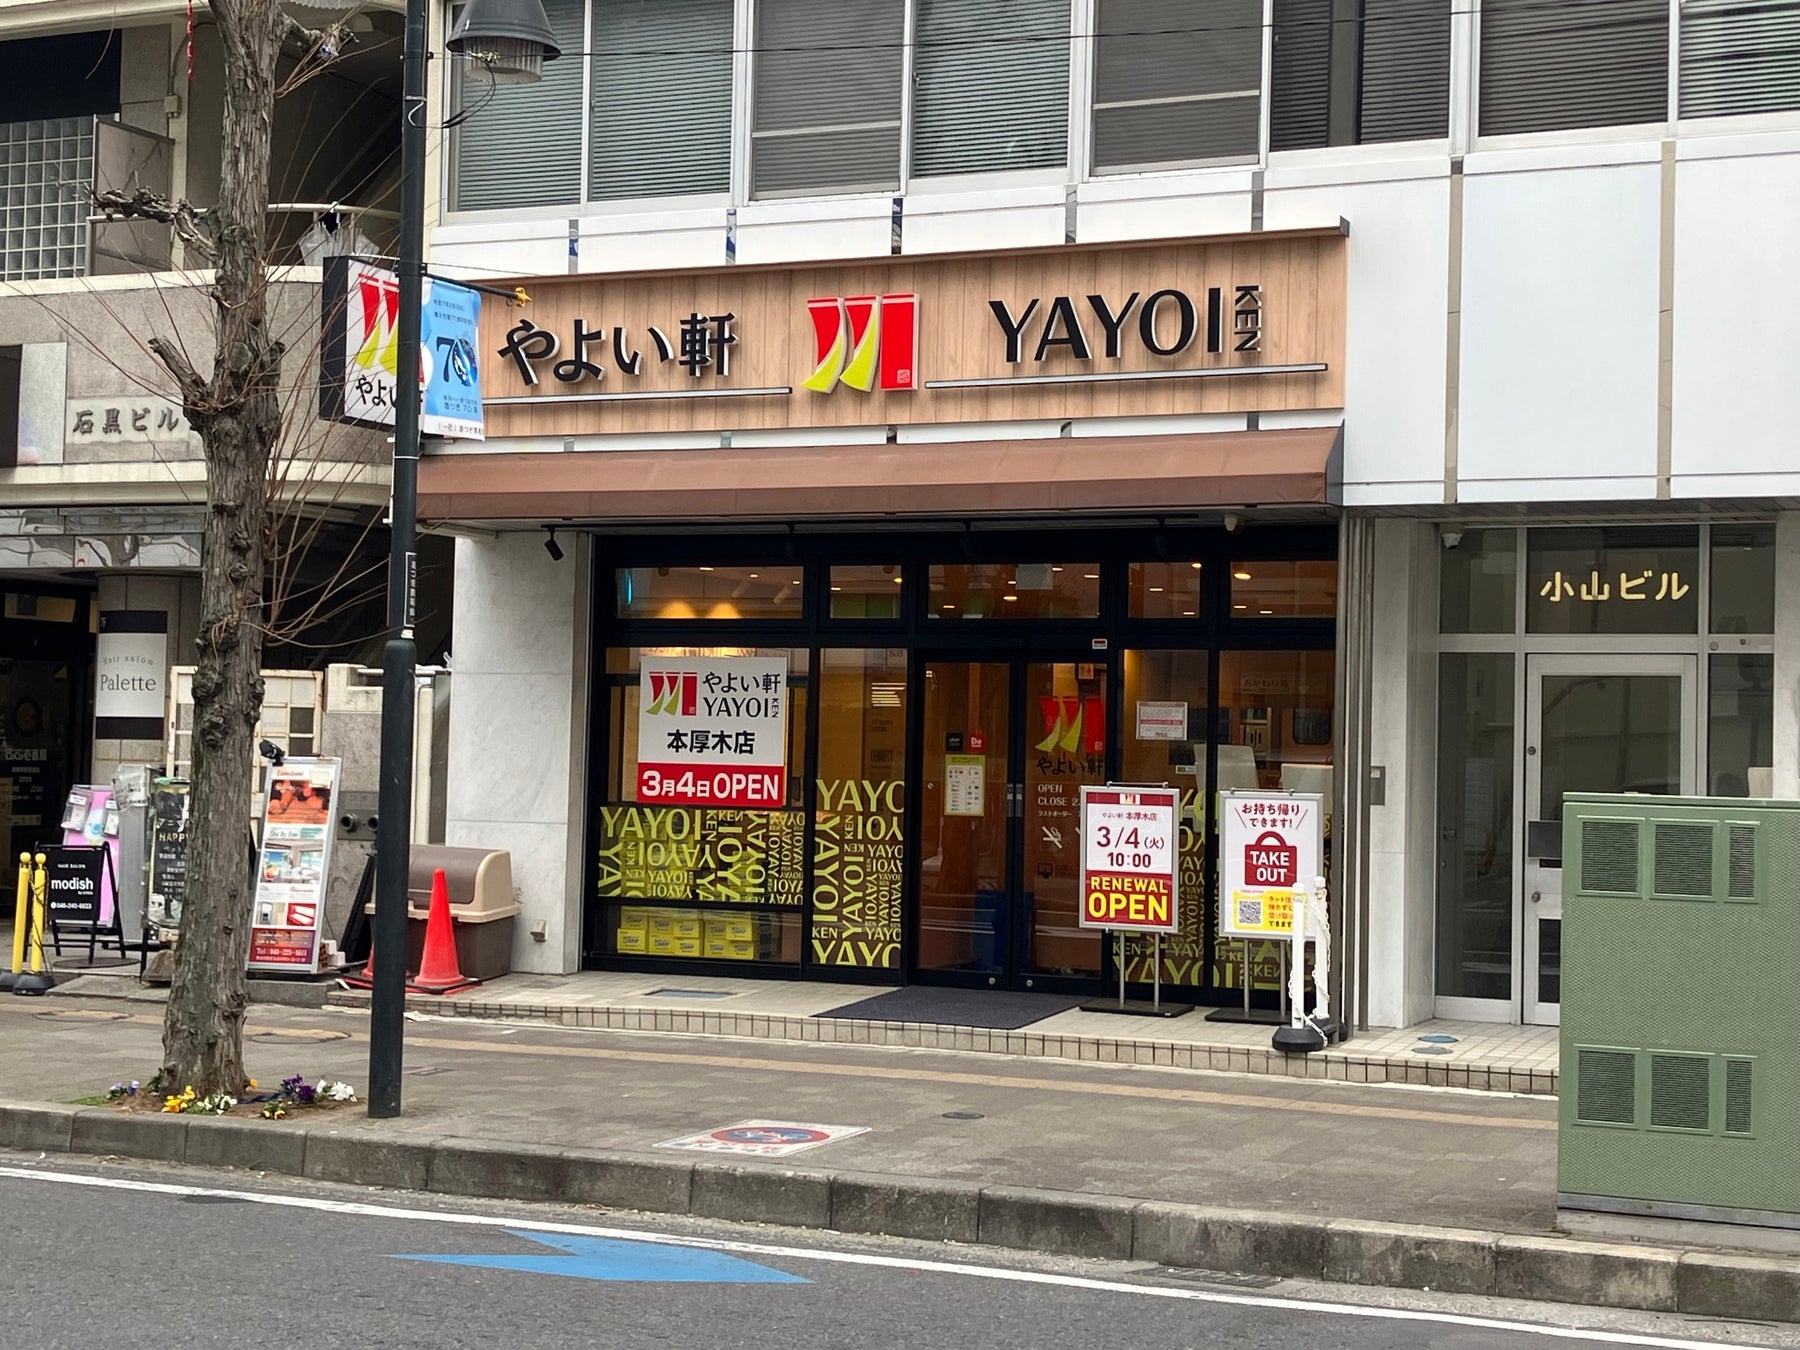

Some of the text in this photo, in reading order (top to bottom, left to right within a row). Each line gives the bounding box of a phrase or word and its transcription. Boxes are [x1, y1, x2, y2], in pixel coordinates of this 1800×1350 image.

[988, 285, 1262, 364] YAYOI KEN
[497, 312, 740, 387] やよい軒
[73, 407, 179, 435] 石黒ビル
[1540, 570, 1689, 601] 小山ビル
[100, 673, 156, 692] Palette
[702, 671, 781, 694] やよい軒
[703, 697, 779, 718] YAYOI KEN
[667, 729, 755, 754] 本厚木店
[1036, 757, 1104, 776] やよい軒
[641, 770, 779, 800] 3月4日OPEN
[1038, 784, 1063, 793] OPEN
[1038, 796, 1068, 806] CLOSE
[1242, 803, 1300, 816] お持ち帰り
[600, 806, 701, 840] YAYOI
[1125, 811, 1158, 821] 本厚木店
[1107, 852, 1152, 868] 10:00
[1250, 850, 1290, 866] TAKE
[51, 877, 94, 890] modish
[1091, 876, 1168, 893] RENEWAL
[1256, 868, 1288, 882] OUT
[1088, 892, 1168, 921] OPEN
[812, 926, 837, 939] KEN
